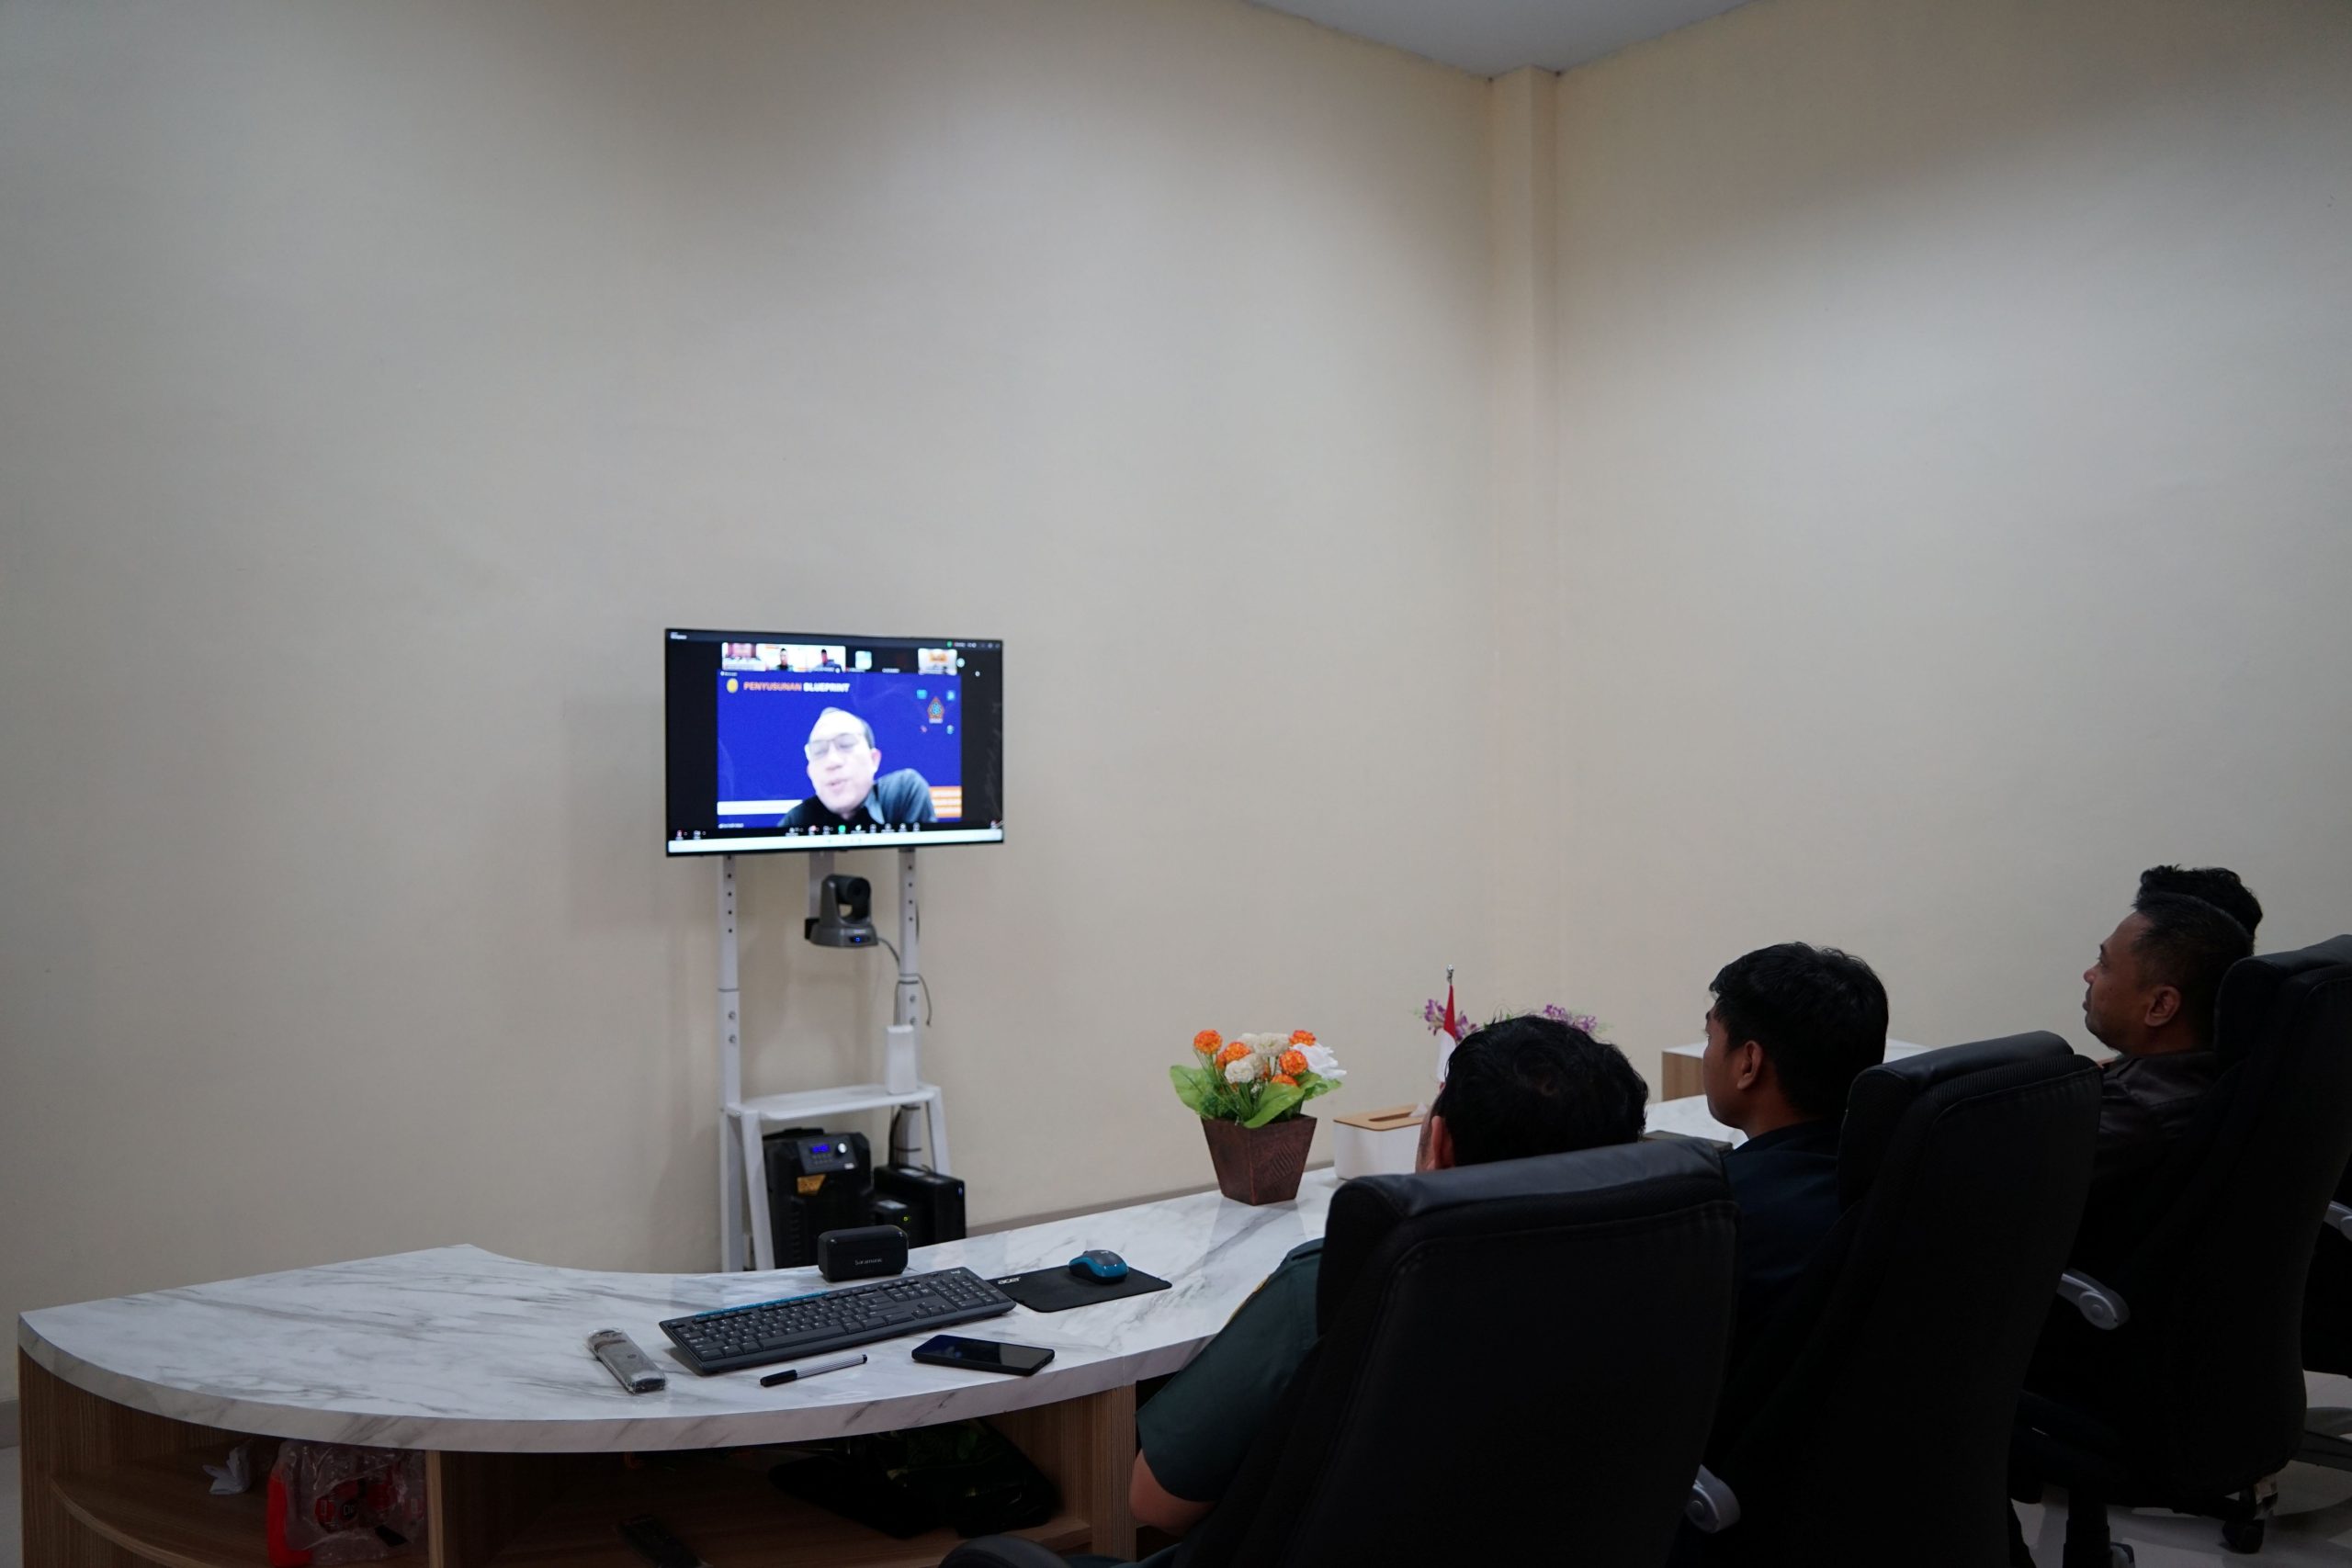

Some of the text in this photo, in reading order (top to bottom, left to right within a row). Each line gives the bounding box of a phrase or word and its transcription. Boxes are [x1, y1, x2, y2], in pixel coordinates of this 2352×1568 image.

[743, 681, 850, 693] PENYUSUNAN BLUEPRINT
[997, 1276, 1022, 1285] acer
